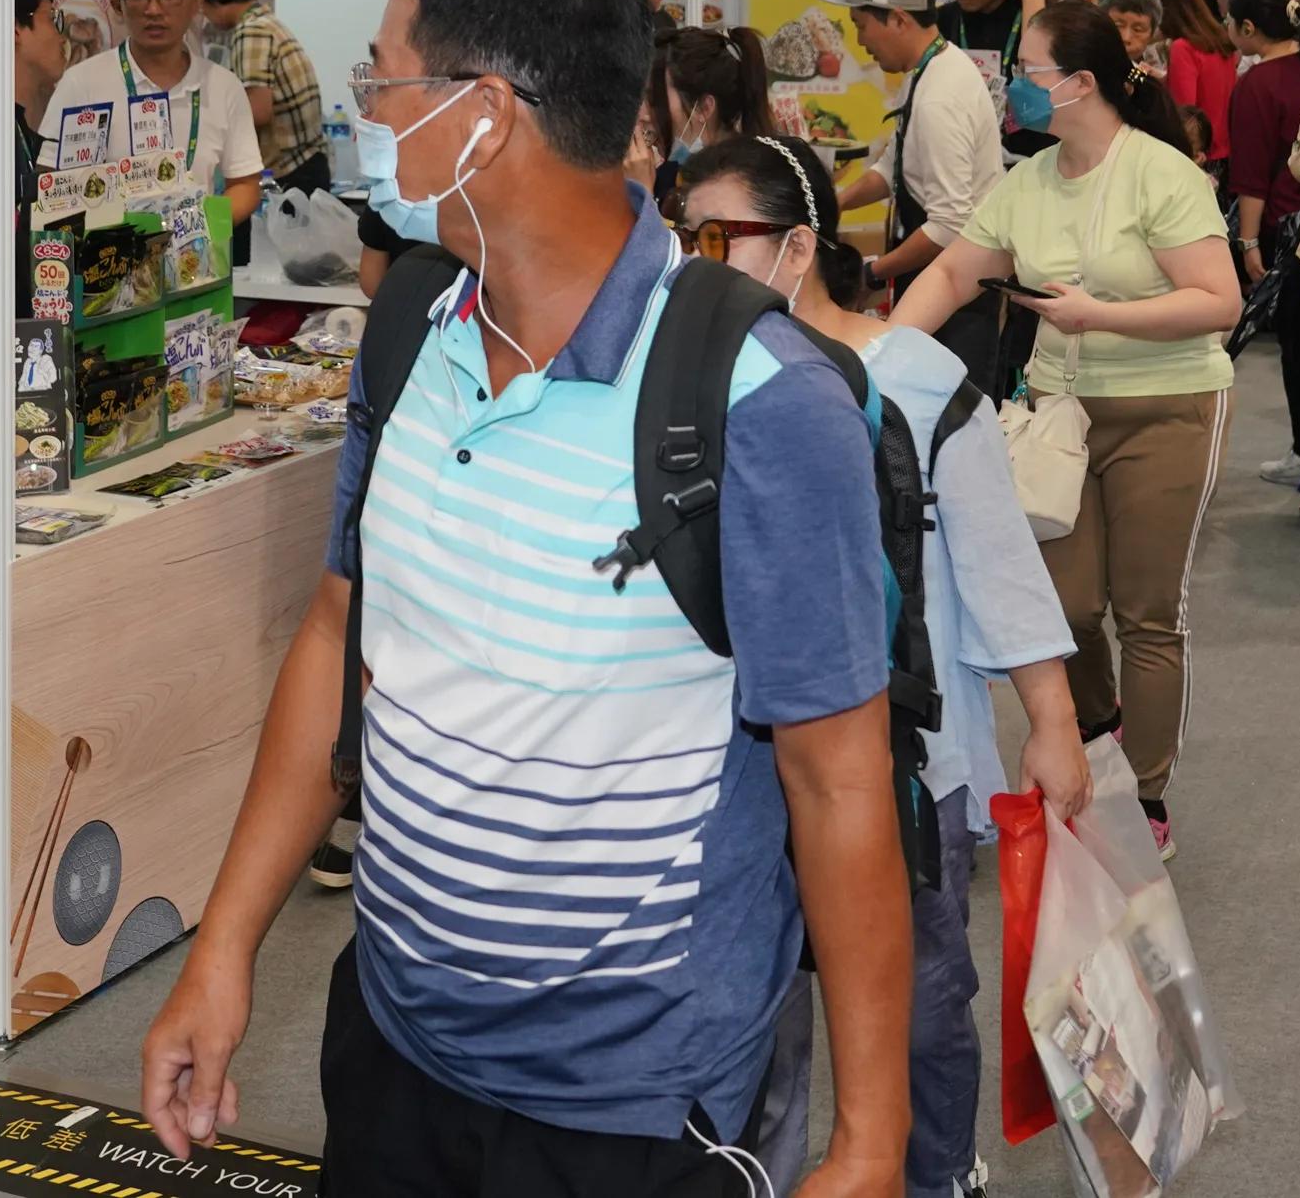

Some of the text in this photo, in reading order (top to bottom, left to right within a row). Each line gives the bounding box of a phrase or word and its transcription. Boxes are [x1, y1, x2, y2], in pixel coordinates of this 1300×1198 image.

[146, 135, 159, 148] 100
[76, 148, 91, 161] 100
[34, 244, 70, 260] くらこん
[98, 1140, 207, 1181] WATCH
